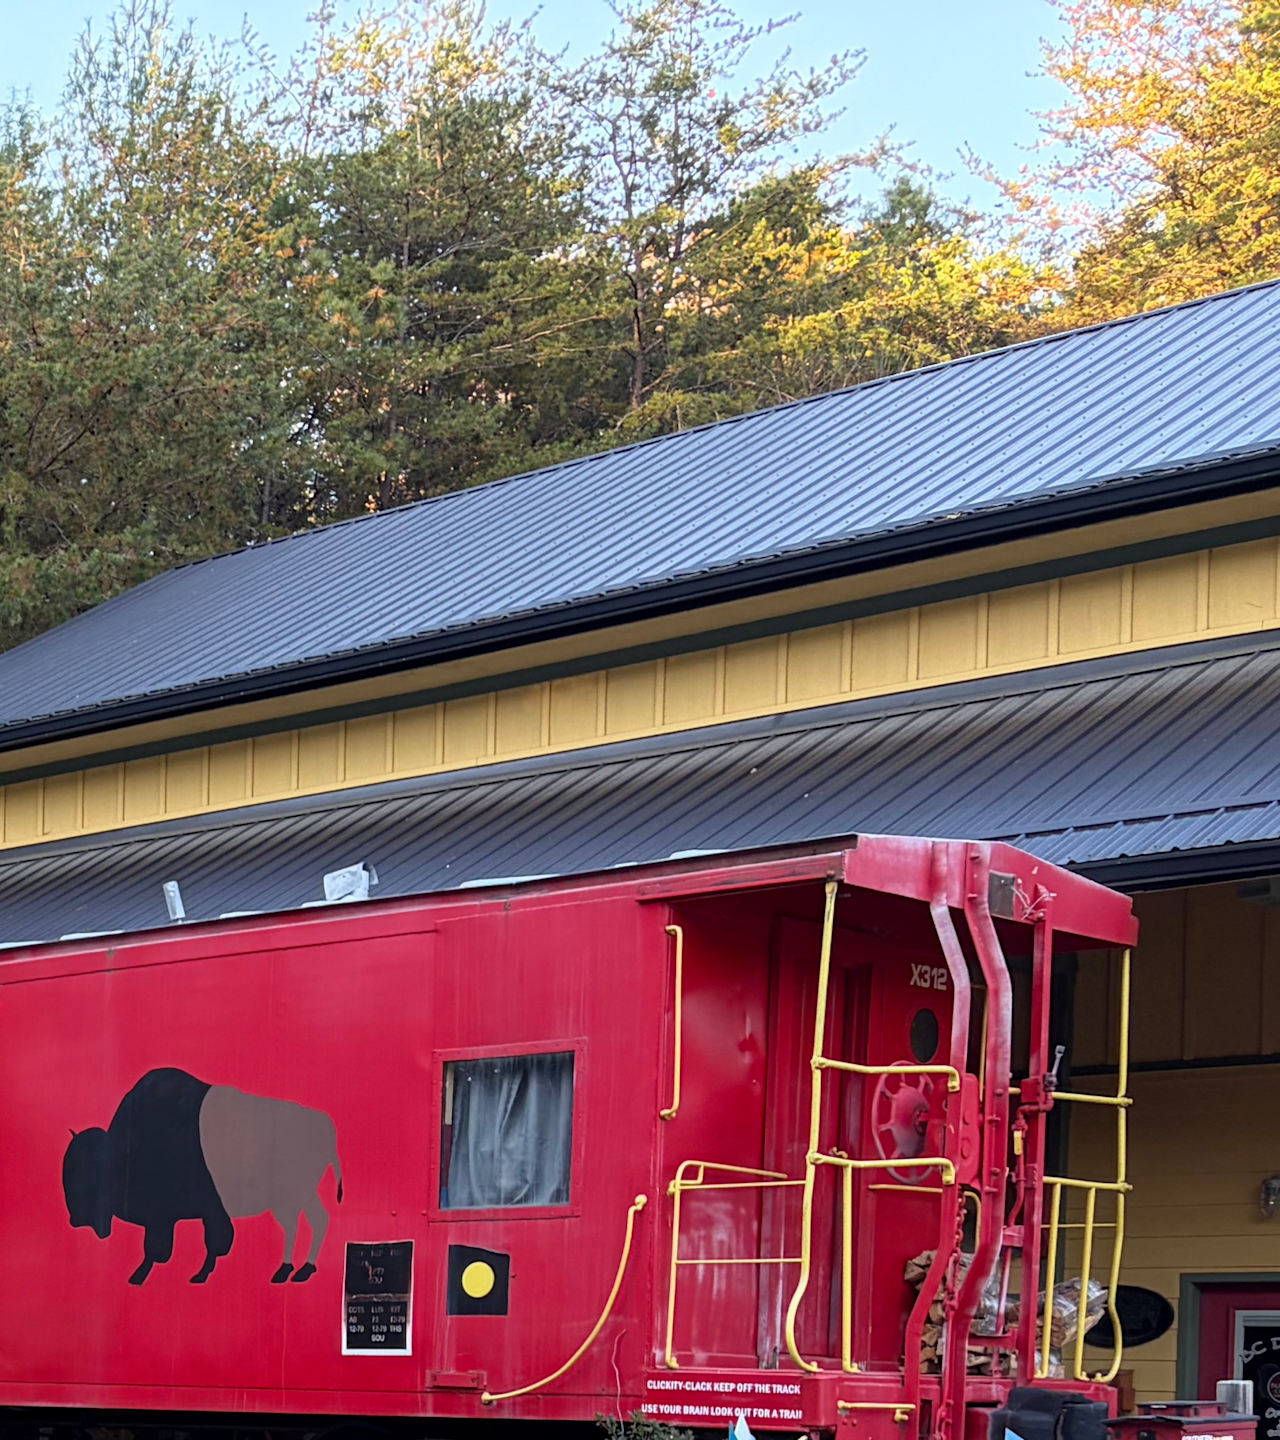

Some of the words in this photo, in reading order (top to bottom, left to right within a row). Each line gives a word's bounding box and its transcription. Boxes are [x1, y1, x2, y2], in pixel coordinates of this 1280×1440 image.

[910, 963, 947, 991] X312
[646, 1380, 712, 1391] CLICKITY-CLACK
[713, 1382, 736, 1393] KEEP
[737, 1383, 753, 1393] OFF
[754, 1383, 770, 1394] THE
[772, 1384, 800, 1395] TRACK
[641, 1403, 658, 1414] USE
[659, 1404, 682, 1415] YOUR
[683, 1405, 709, 1416] BRAIN
[710, 1406, 733, 1417] LOOK
[734, 1407, 751, 1418] OUT
[753, 1408, 770, 1418] FOR
[771, 1409, 778, 1418] A
